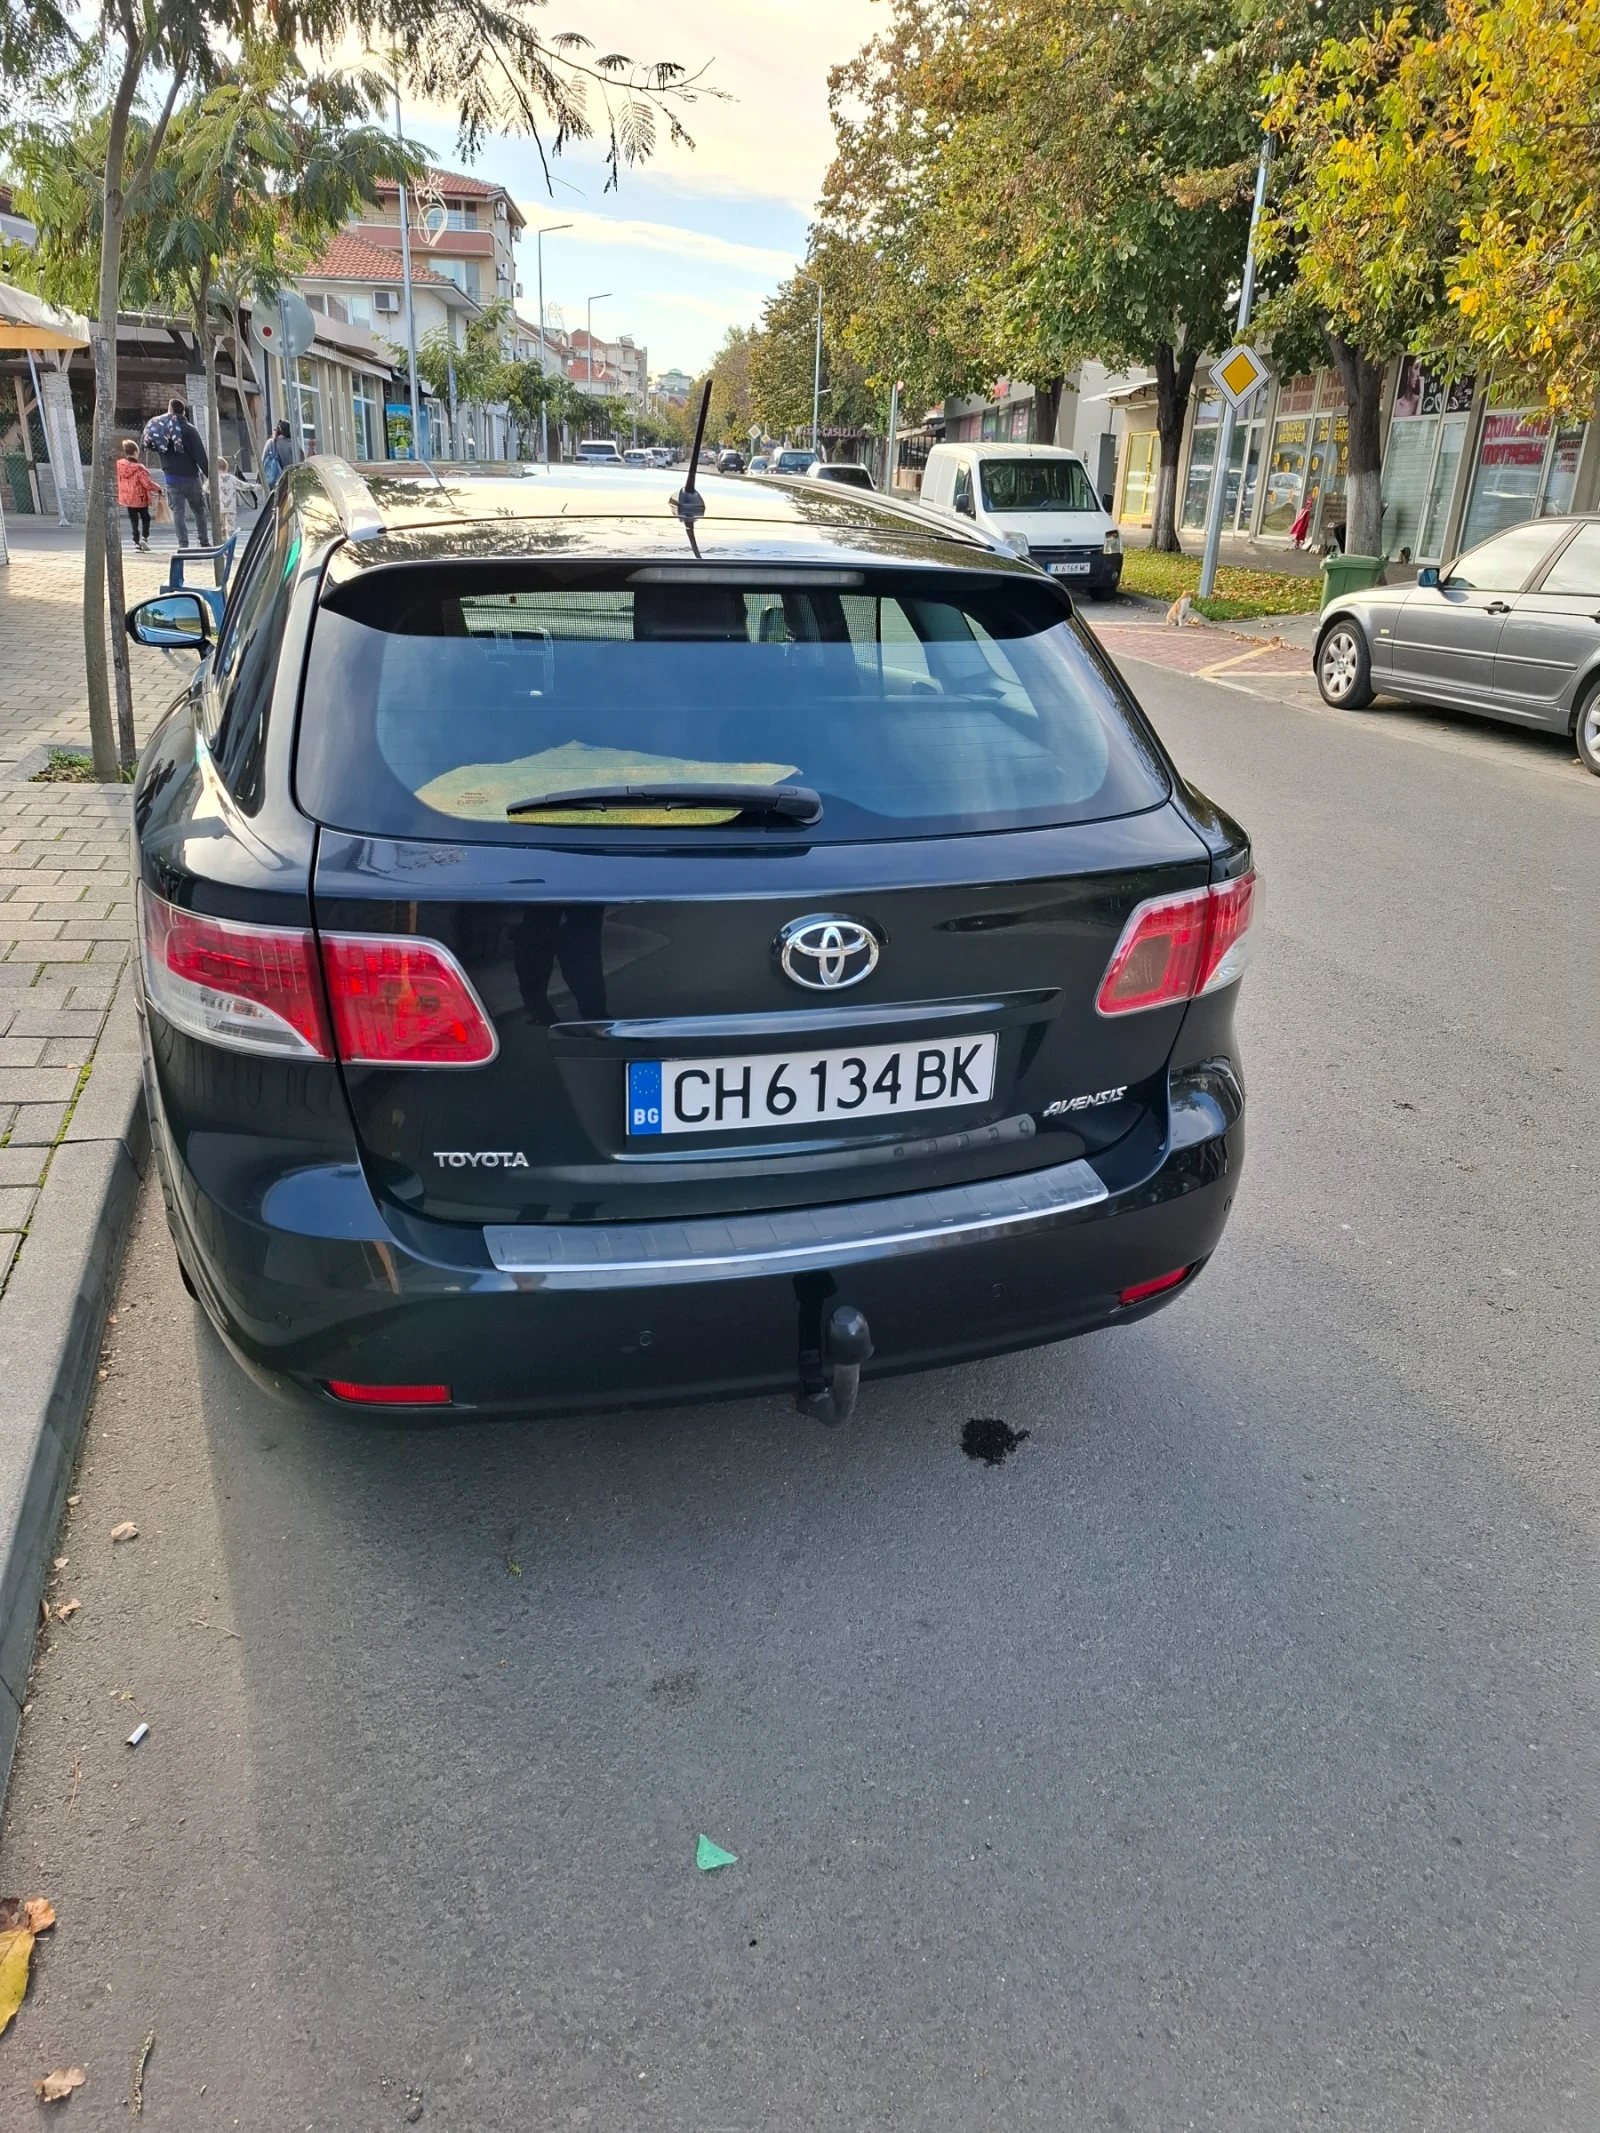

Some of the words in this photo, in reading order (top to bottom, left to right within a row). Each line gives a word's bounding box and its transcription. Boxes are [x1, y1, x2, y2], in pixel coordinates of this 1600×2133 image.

[1043, 1086, 1128, 1117] AVENSIS
[634, 1108, 659, 1125] BG
[433, 1152, 530, 1168] TOYOTA
